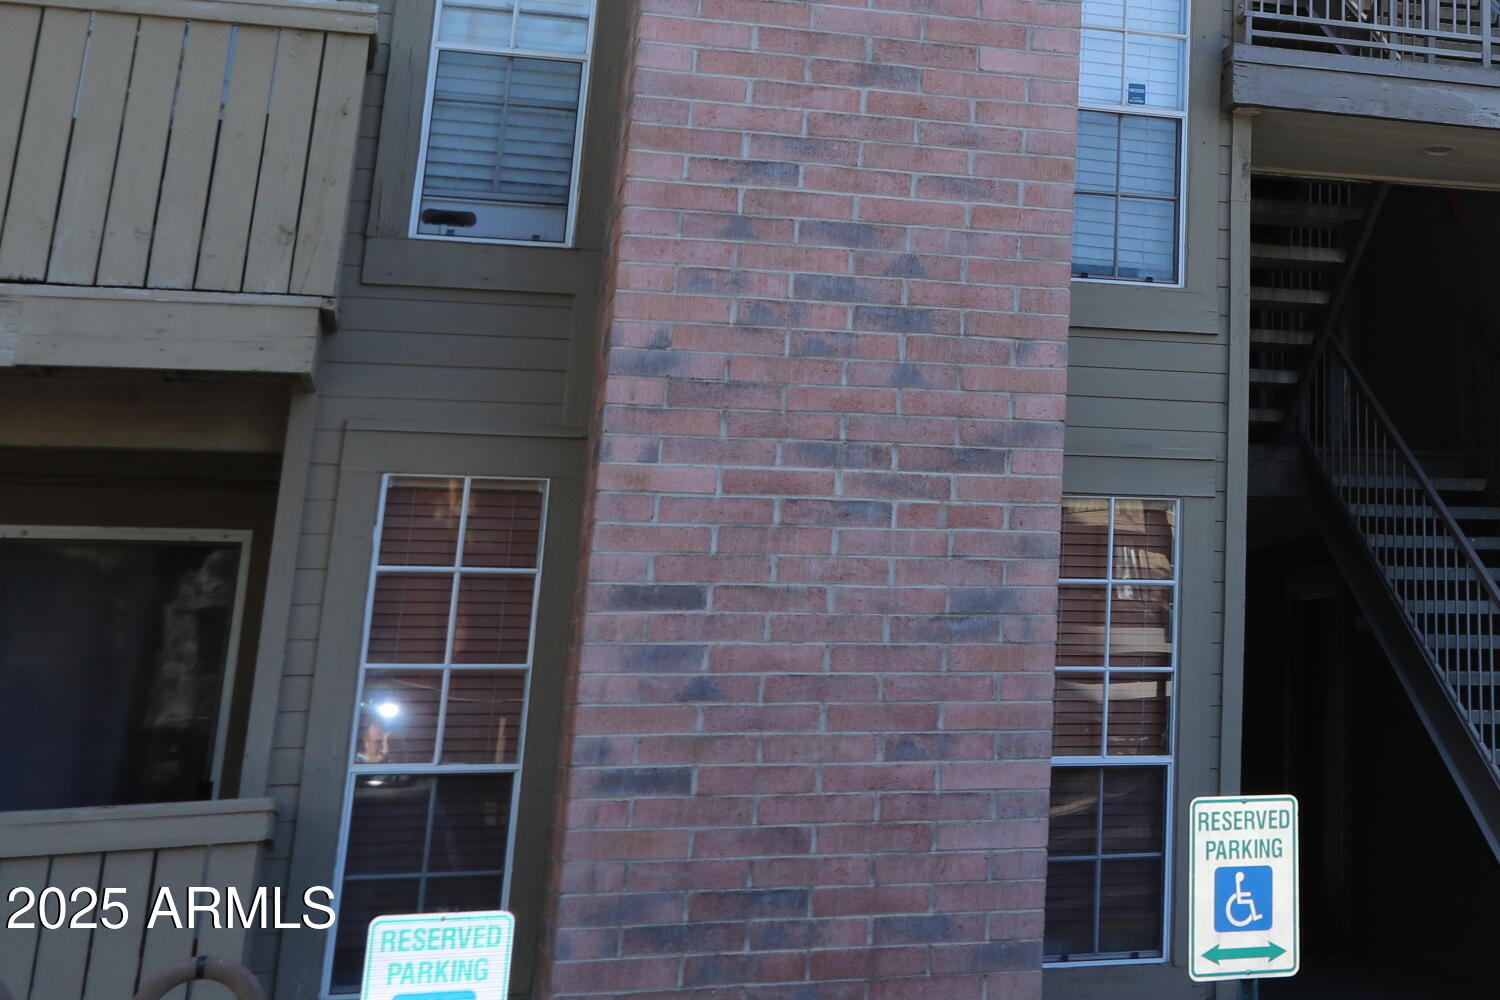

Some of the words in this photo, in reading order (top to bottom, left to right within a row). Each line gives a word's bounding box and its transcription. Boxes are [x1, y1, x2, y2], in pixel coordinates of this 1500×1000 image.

[1198, 809, 1290, 832] RESERVED
[1205, 838, 1283, 861] PARKING
[380, 925, 502, 952] RESERVED
[387, 957, 489, 985] PARKING
